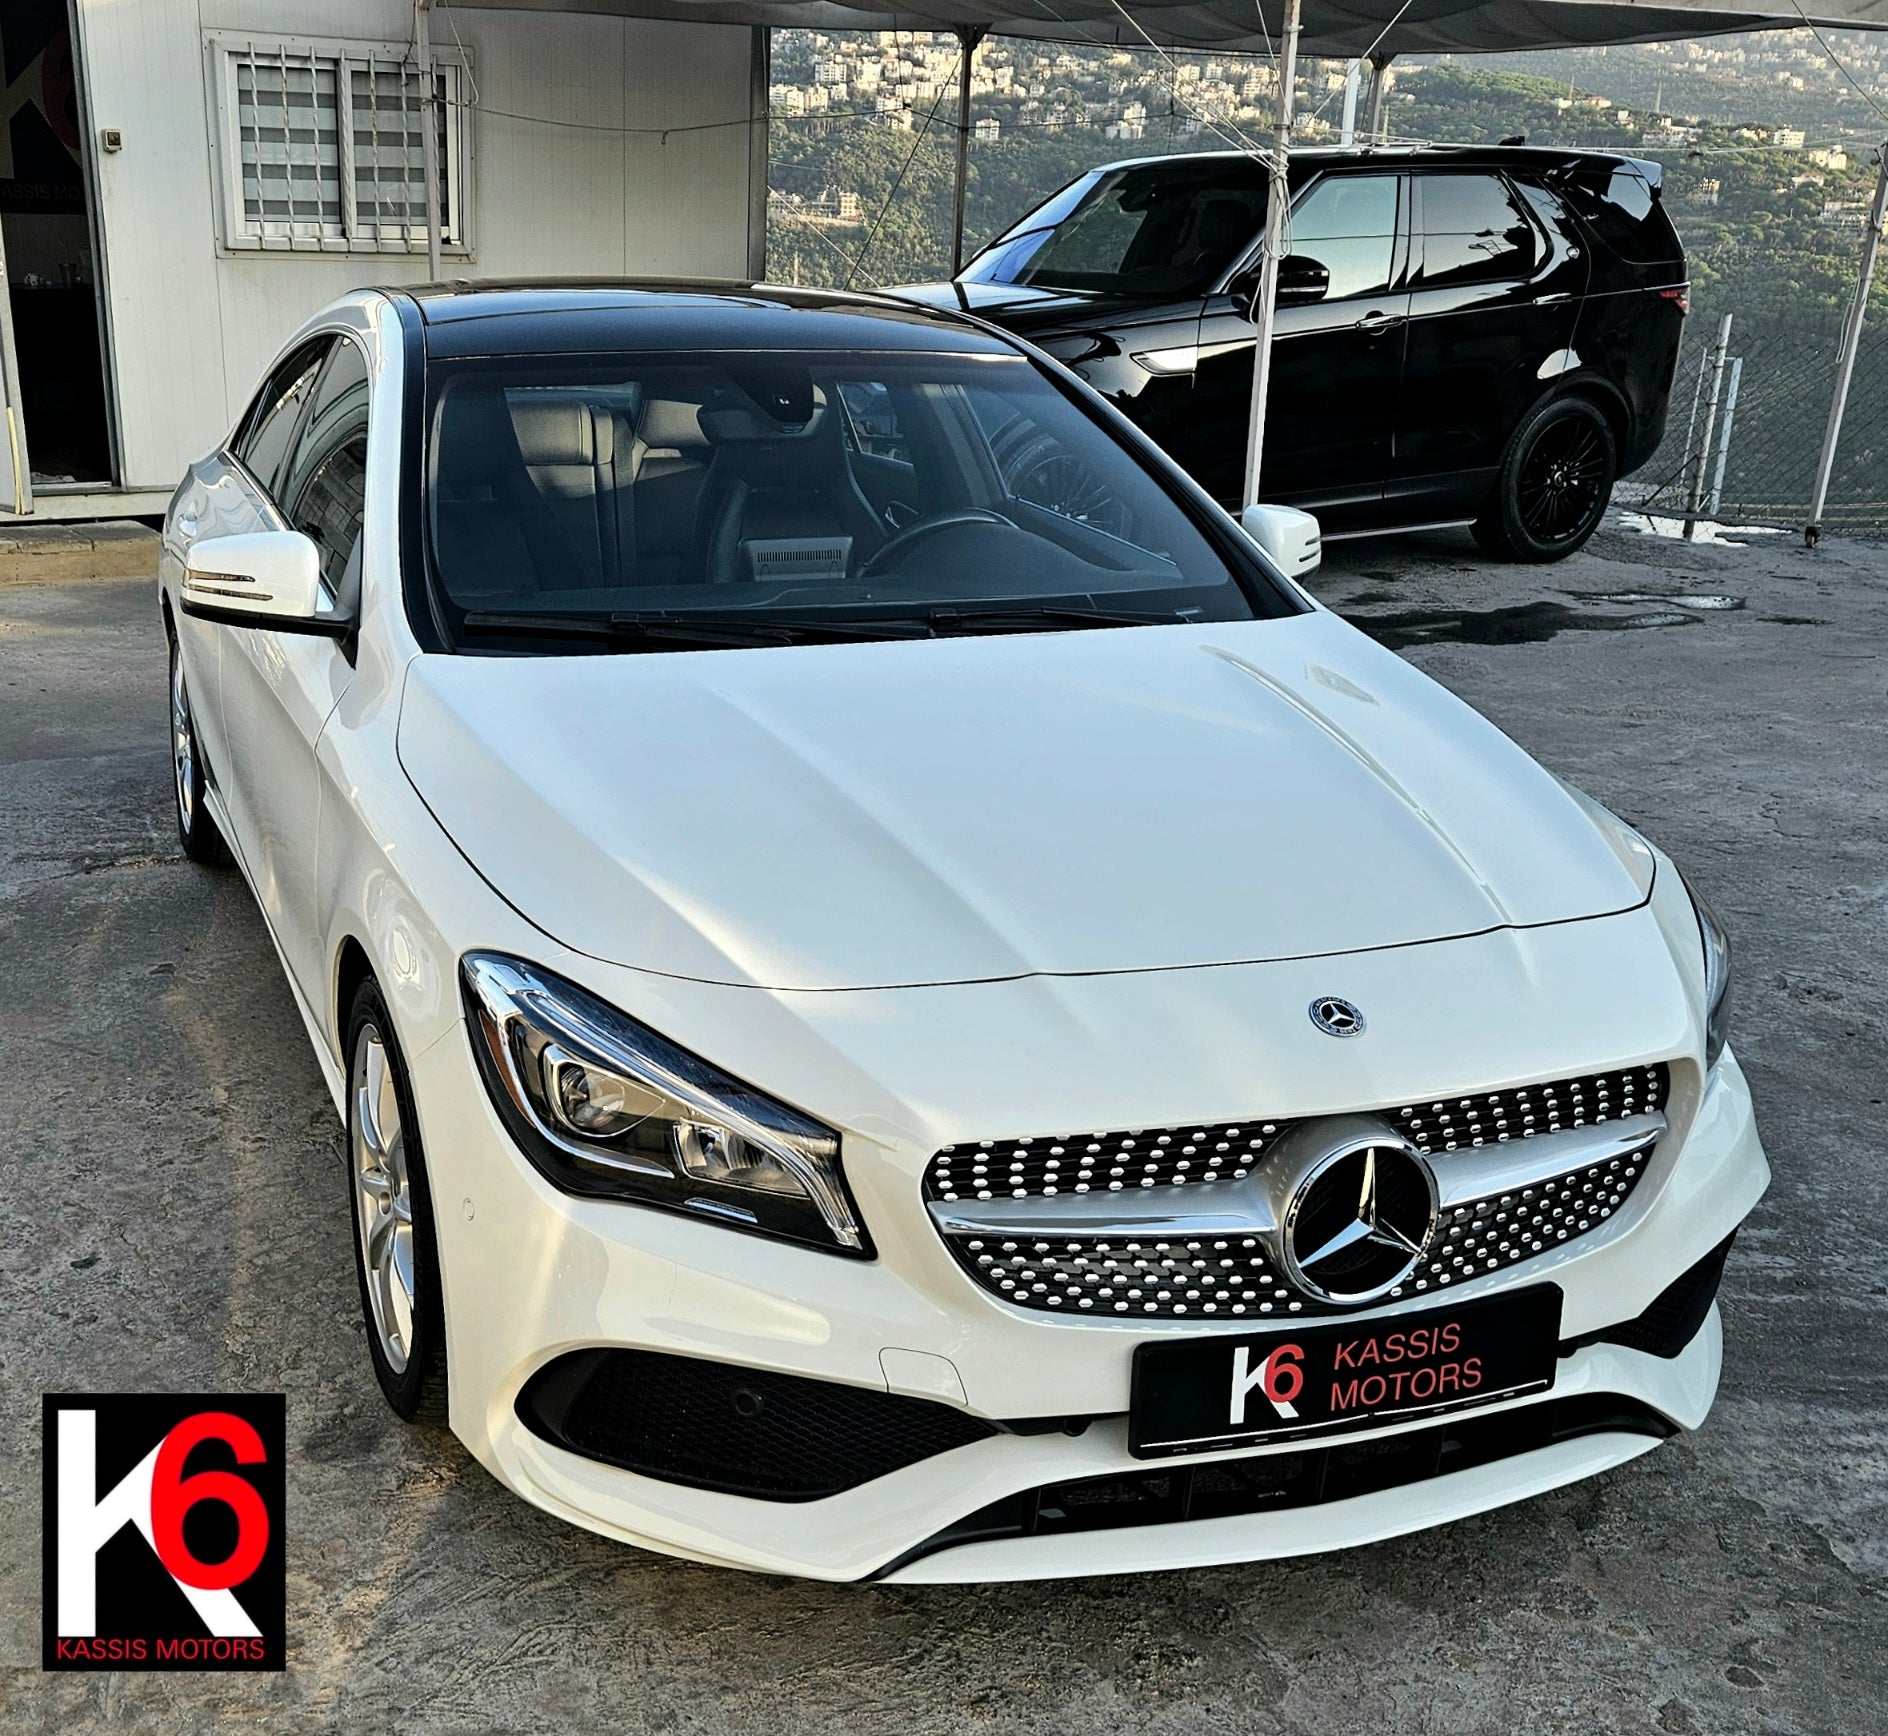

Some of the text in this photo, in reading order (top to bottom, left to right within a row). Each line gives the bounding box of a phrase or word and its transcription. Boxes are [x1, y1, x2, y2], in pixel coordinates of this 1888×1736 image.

[0, 184, 49, 200] ASSIS
[1334, 1323, 1461, 1369] KASSIS
[1230, 1343, 1305, 1424] K6
[1330, 1357, 1482, 1411] MOTORS
